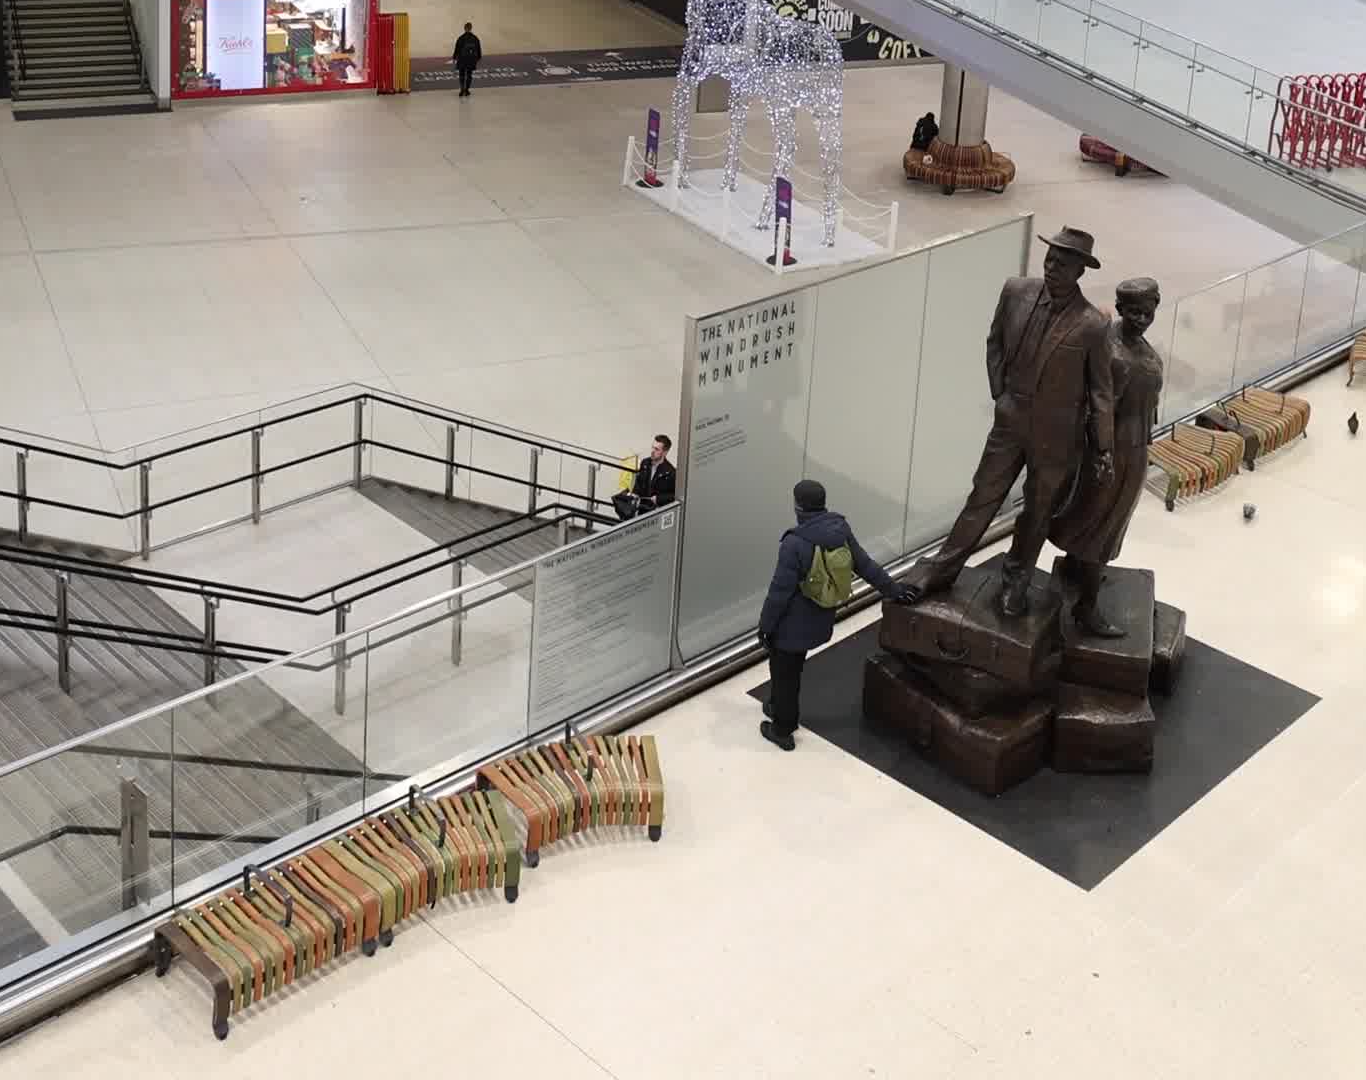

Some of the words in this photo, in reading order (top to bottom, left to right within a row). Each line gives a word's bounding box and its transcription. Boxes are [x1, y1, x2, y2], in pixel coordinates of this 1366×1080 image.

[817, 7, 854, 33] SOON
[701, 323, 723, 342] THE
[727, 300, 796, 334] NATIONAL
[700, 321, 796, 365] WINDRUSH
[698, 342, 794, 388] MONUMENT
